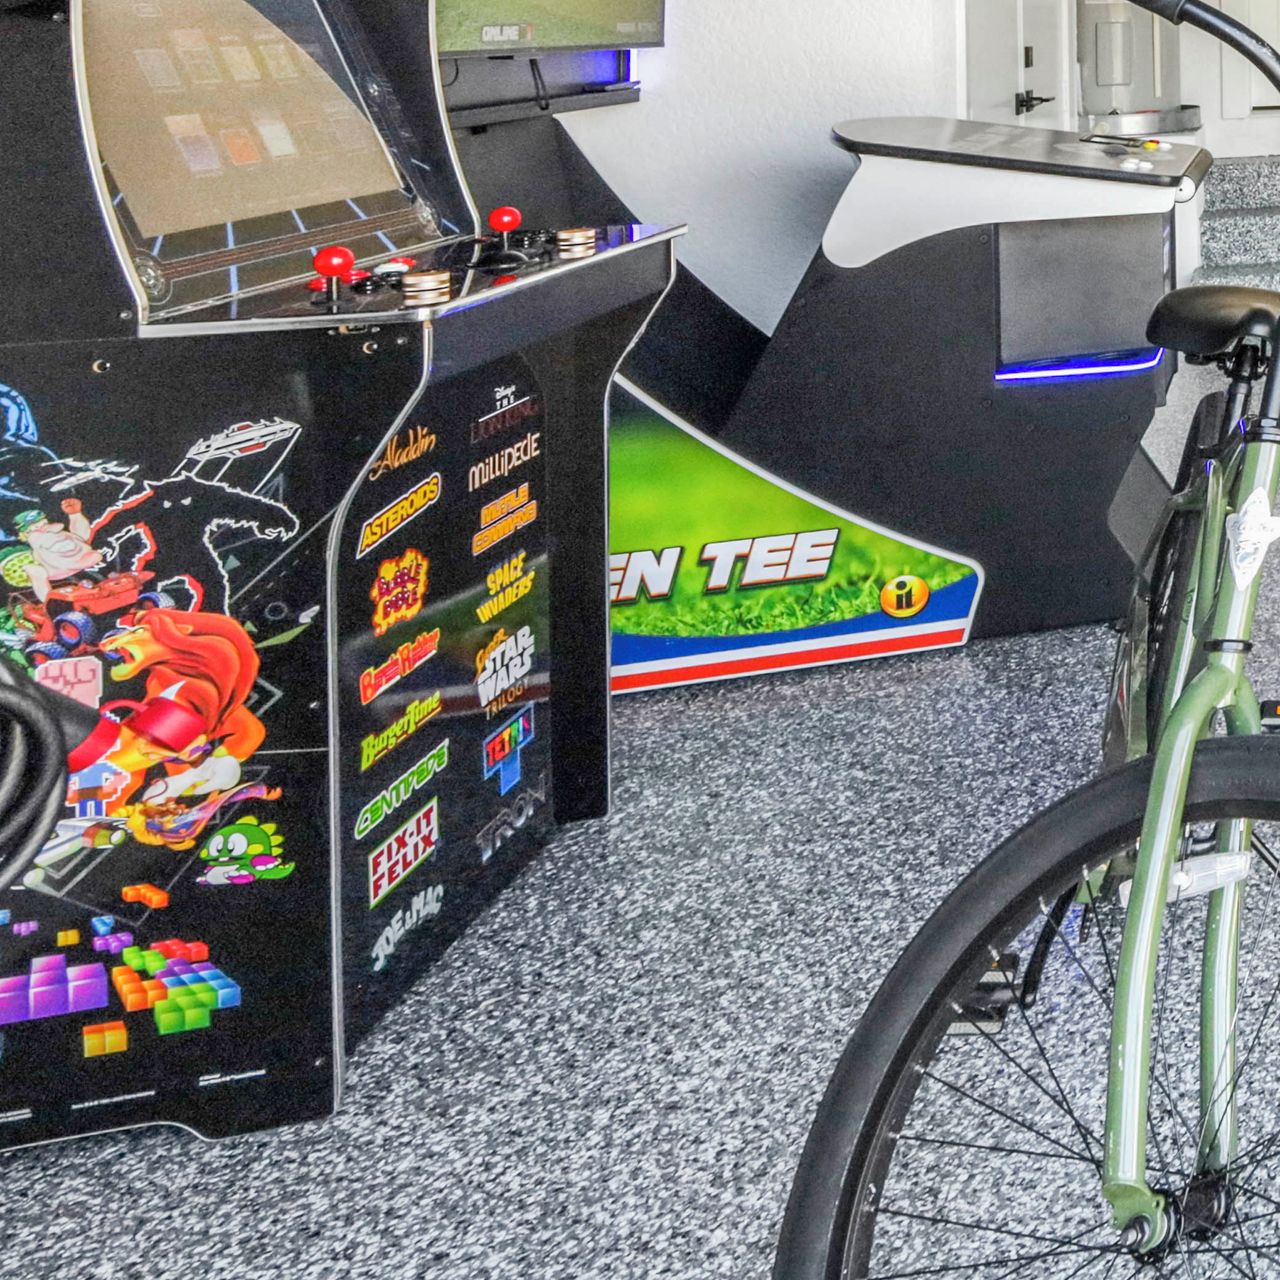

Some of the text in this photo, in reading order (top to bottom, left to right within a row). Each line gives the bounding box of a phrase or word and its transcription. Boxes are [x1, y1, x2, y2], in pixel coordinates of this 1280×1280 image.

[368, 424, 437, 482] Aladdin
[358, 474, 440, 554] ASTEROIDS
[486, 550, 527, 596] SPACE
[699, 528, 841, 594] TEE
[476, 569, 536, 624] INVADERS
[478, 648, 534, 708] WARS
[485, 625, 535, 672] STAR
[485, 678, 530, 720] TRILOGY
[484, 708, 531, 768] TETRIS
[355, 739, 449, 840] CENTIPEDE
[476, 773, 545, 865] TRON
[371, 805, 434, 877] FIX-IT
[372, 829, 436, 901] FELIX
[371, 909, 405, 972] JOE
[411, 884, 444, 925] MAC
